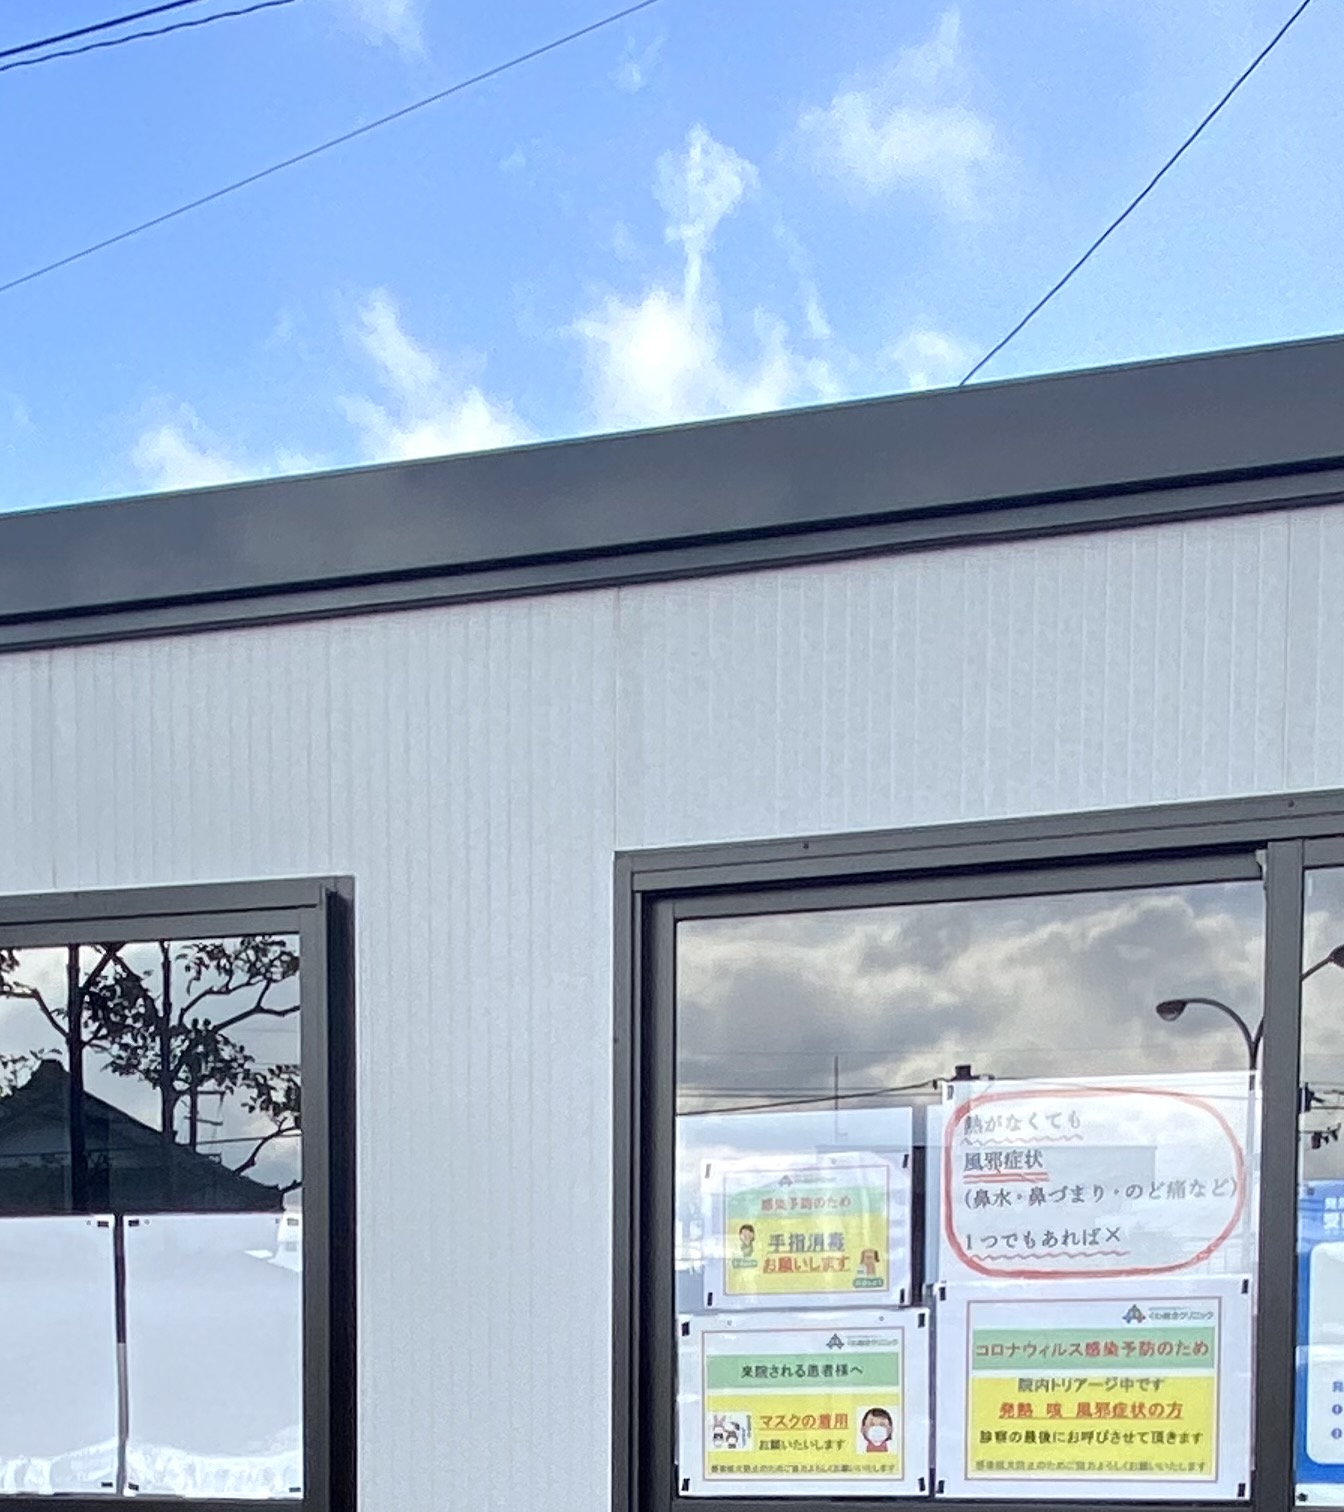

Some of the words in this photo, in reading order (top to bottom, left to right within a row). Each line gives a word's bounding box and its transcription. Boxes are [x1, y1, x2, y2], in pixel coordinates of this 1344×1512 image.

[964, 1110, 1082, 1135] 熱がなくても
[964, 1149, 1045, 1172] 風邪症状
[761, 1195, 852, 1212] 感染予防のため
[768, 1231, 846, 1252] 手指消毒
[763, 1255, 851, 1273] お願いします
[975, 1339, 1210, 1358] コロナウィルス感染予防のため
[741, 1363, 864, 1379] 来院される患者様へ
[1017, 1377, 1165, 1393] 院内トリアージ中です
[999, 1401, 1034, 1418] 発熱
[1046, 1401, 1064, 1418] 咳
[1076, 1400, 1184, 1418] 風邪症状の方
[759, 1413, 849, 1430] マスクの着用
[979, 1429, 1204, 1444] 診察の最後にお呼びさせて頂きます
